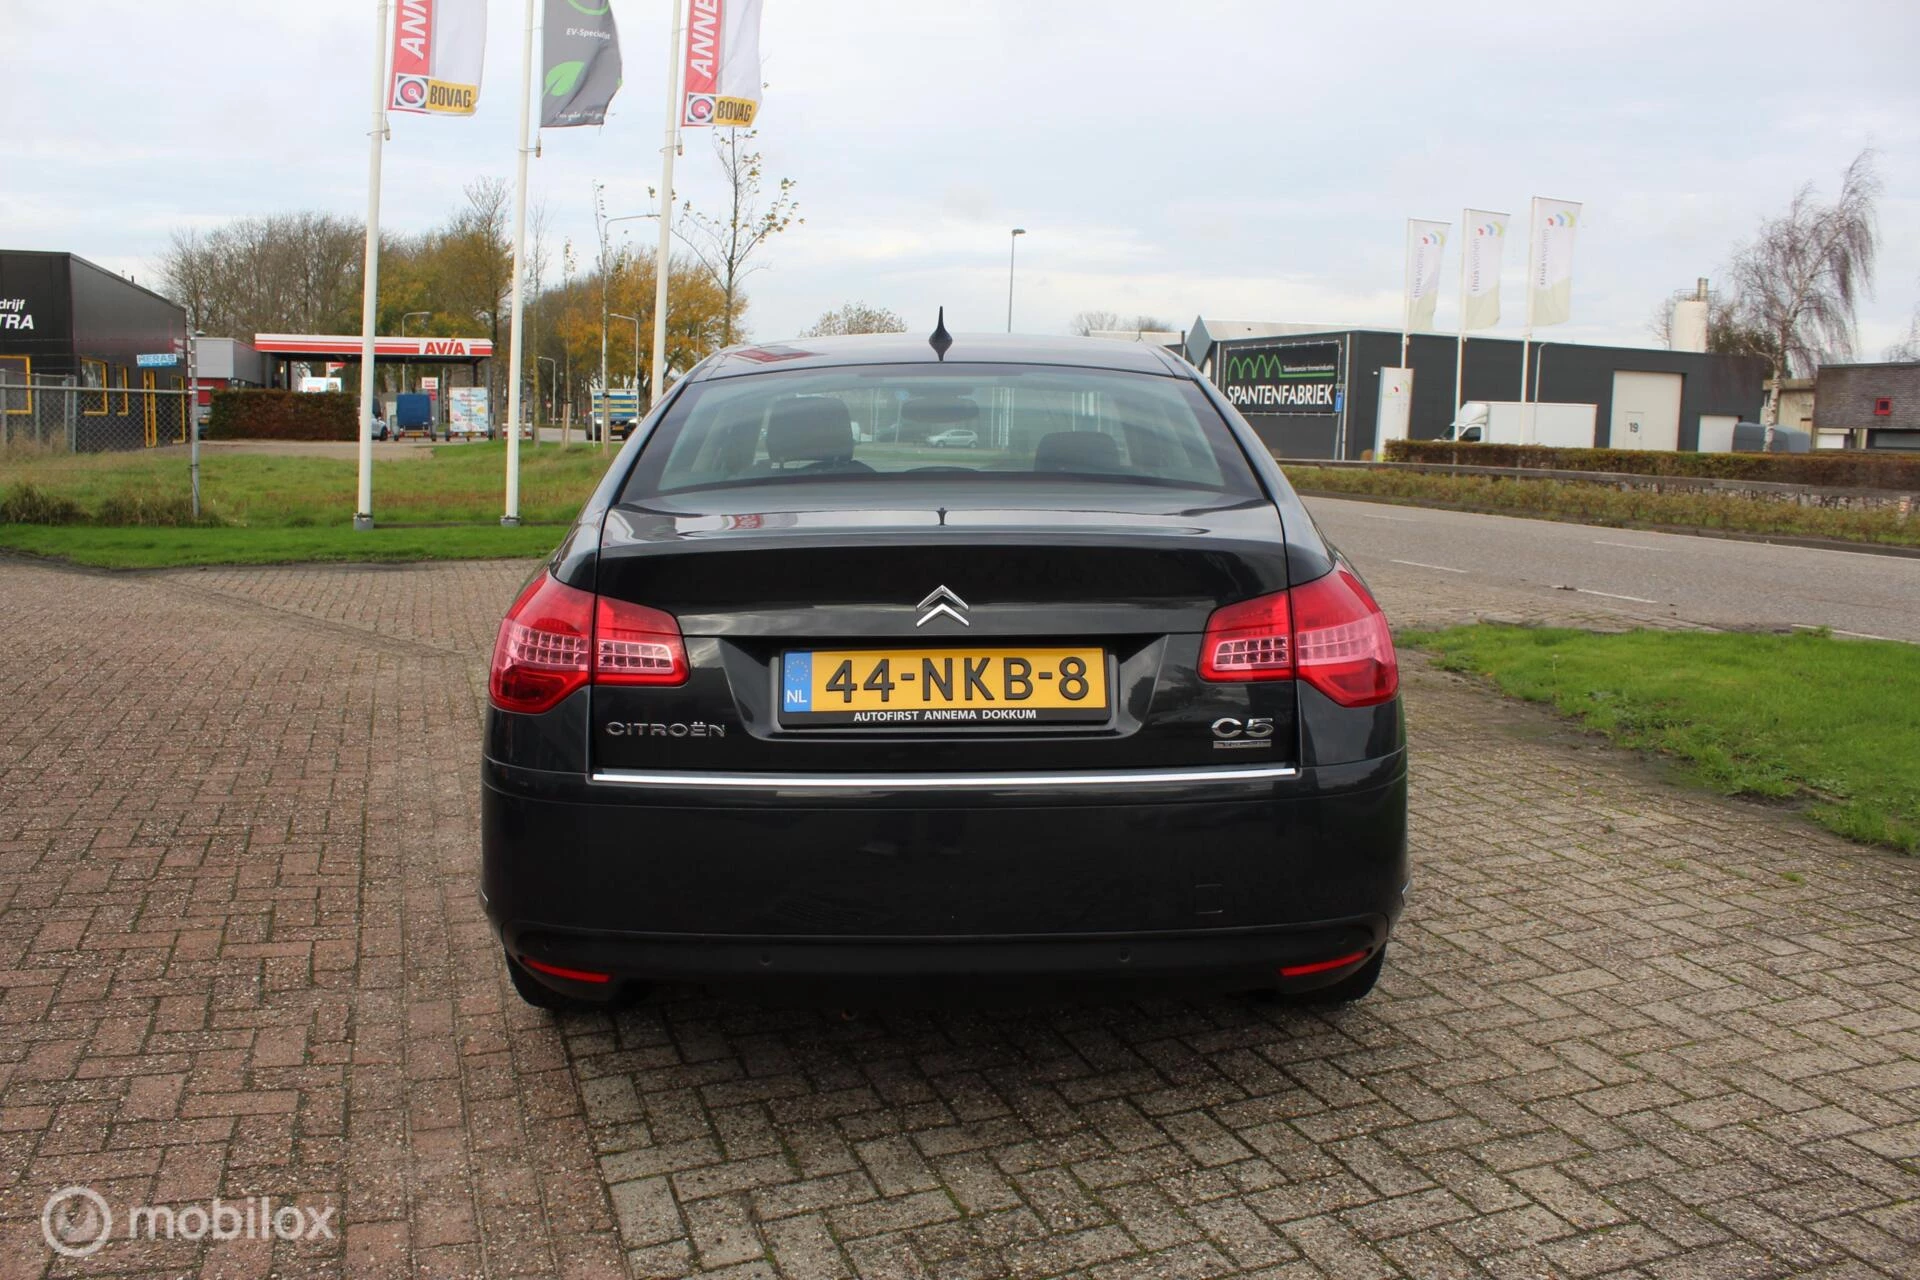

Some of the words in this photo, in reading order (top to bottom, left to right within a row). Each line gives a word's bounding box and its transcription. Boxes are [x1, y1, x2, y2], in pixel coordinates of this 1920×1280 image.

[566, 28, 611, 40] EV-Specialist
[429, 85, 472, 108] BOVAG
[717, 100, 753, 122] BOVAG
[424, 339, 466, 355] AVIA
[138, 354, 176, 362] HERAS
[1227, 384, 1334, 405] SPANTENFABRIEK
[1629, 422, 1639, 433] 19
[825, 656, 1090, 703] 44-NKB-8
[786, 690, 808, 703] NL
[853, 711, 919, 722] AUTOFIRST
[924, 710, 978, 720] ANNEMA
[982, 709, 1037, 720] DOKKUM
[606, 721, 726, 737] CITROËN
[1211, 717, 1275, 738] C5
